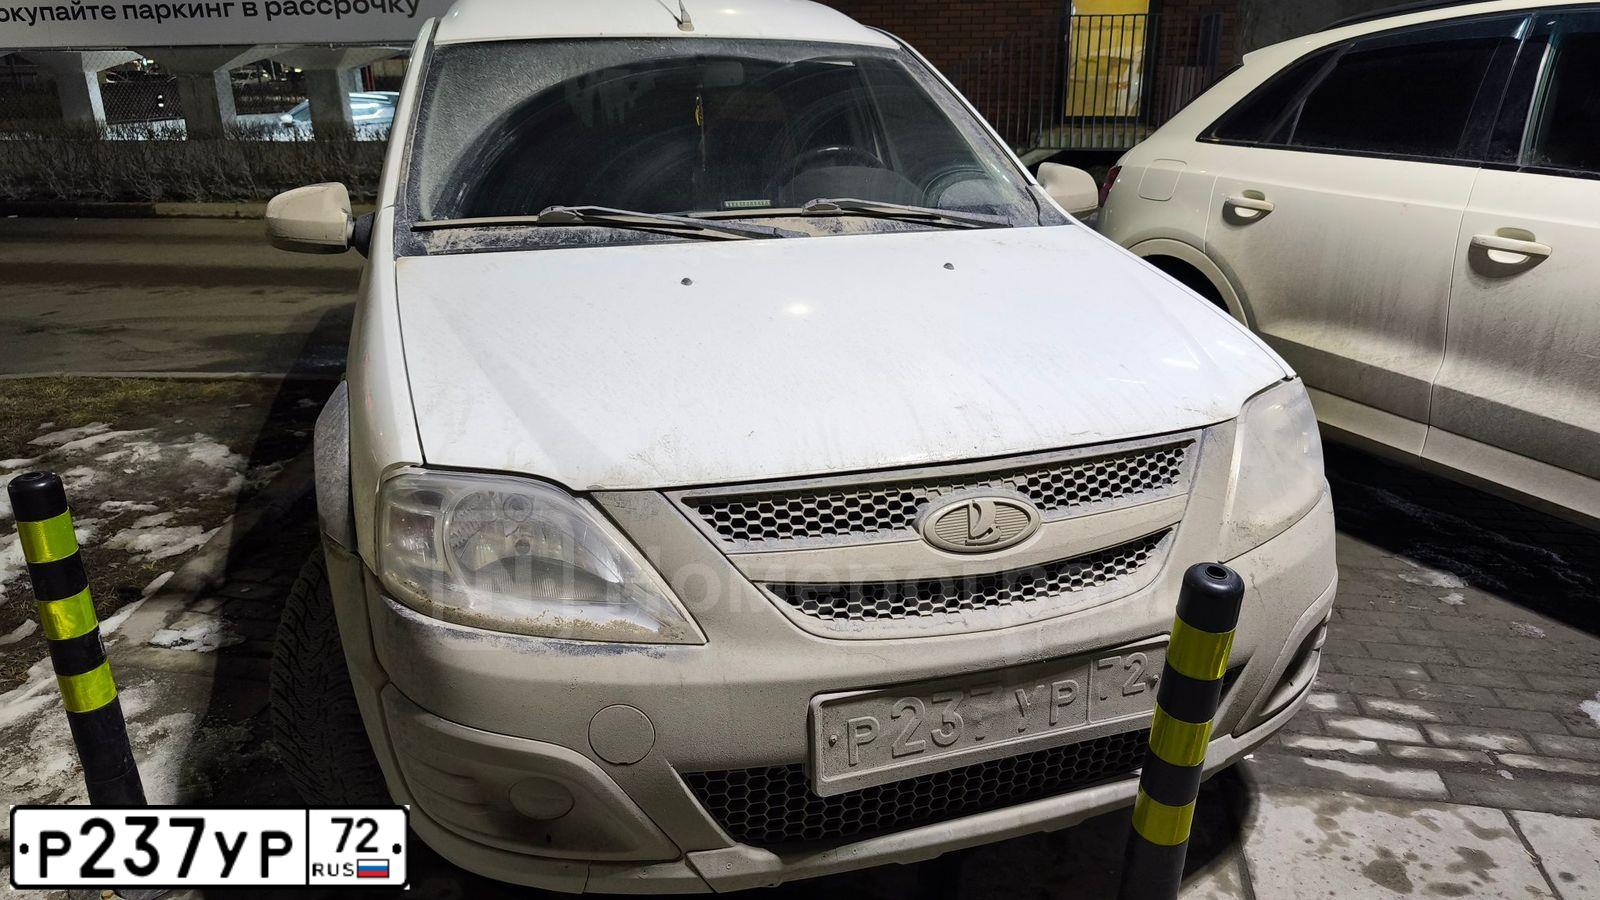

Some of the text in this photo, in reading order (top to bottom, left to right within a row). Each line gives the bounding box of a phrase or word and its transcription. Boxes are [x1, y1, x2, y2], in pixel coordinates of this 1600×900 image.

[122, 2, 234, 23] паркинг
[242, 2, 258, 17] в
[265, 0, 419, 21] рассрочку
